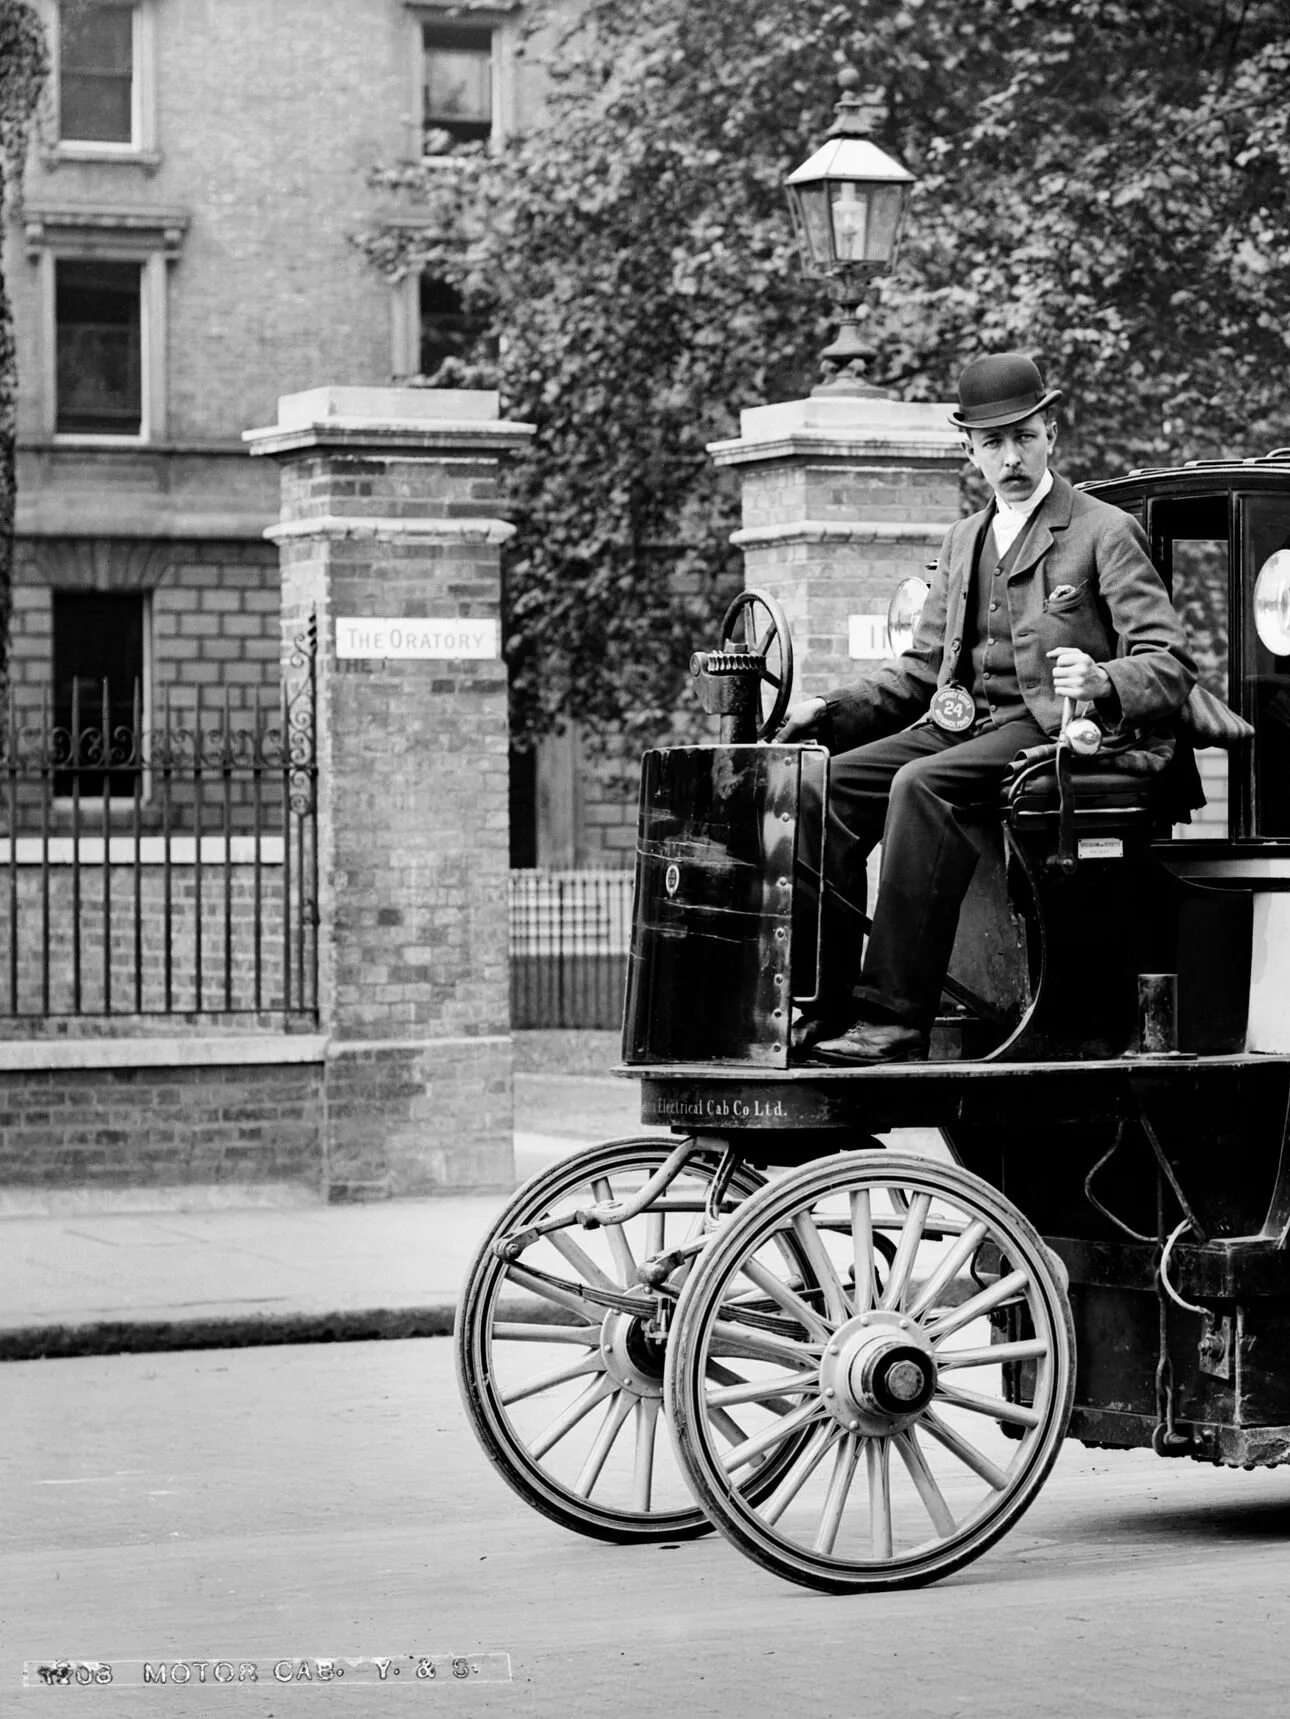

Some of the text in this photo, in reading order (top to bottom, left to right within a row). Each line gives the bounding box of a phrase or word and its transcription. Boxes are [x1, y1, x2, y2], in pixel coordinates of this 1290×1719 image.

[347, 628, 485, 649] THE ORATORY
[943, 700, 963, 718] 24
[658, 1098, 703, 1115] Electrical
[707, 1099, 729, 1115] Cab
[733, 1100, 750, 1116] Co
[754, 1100, 788, 1116] Ltd.
